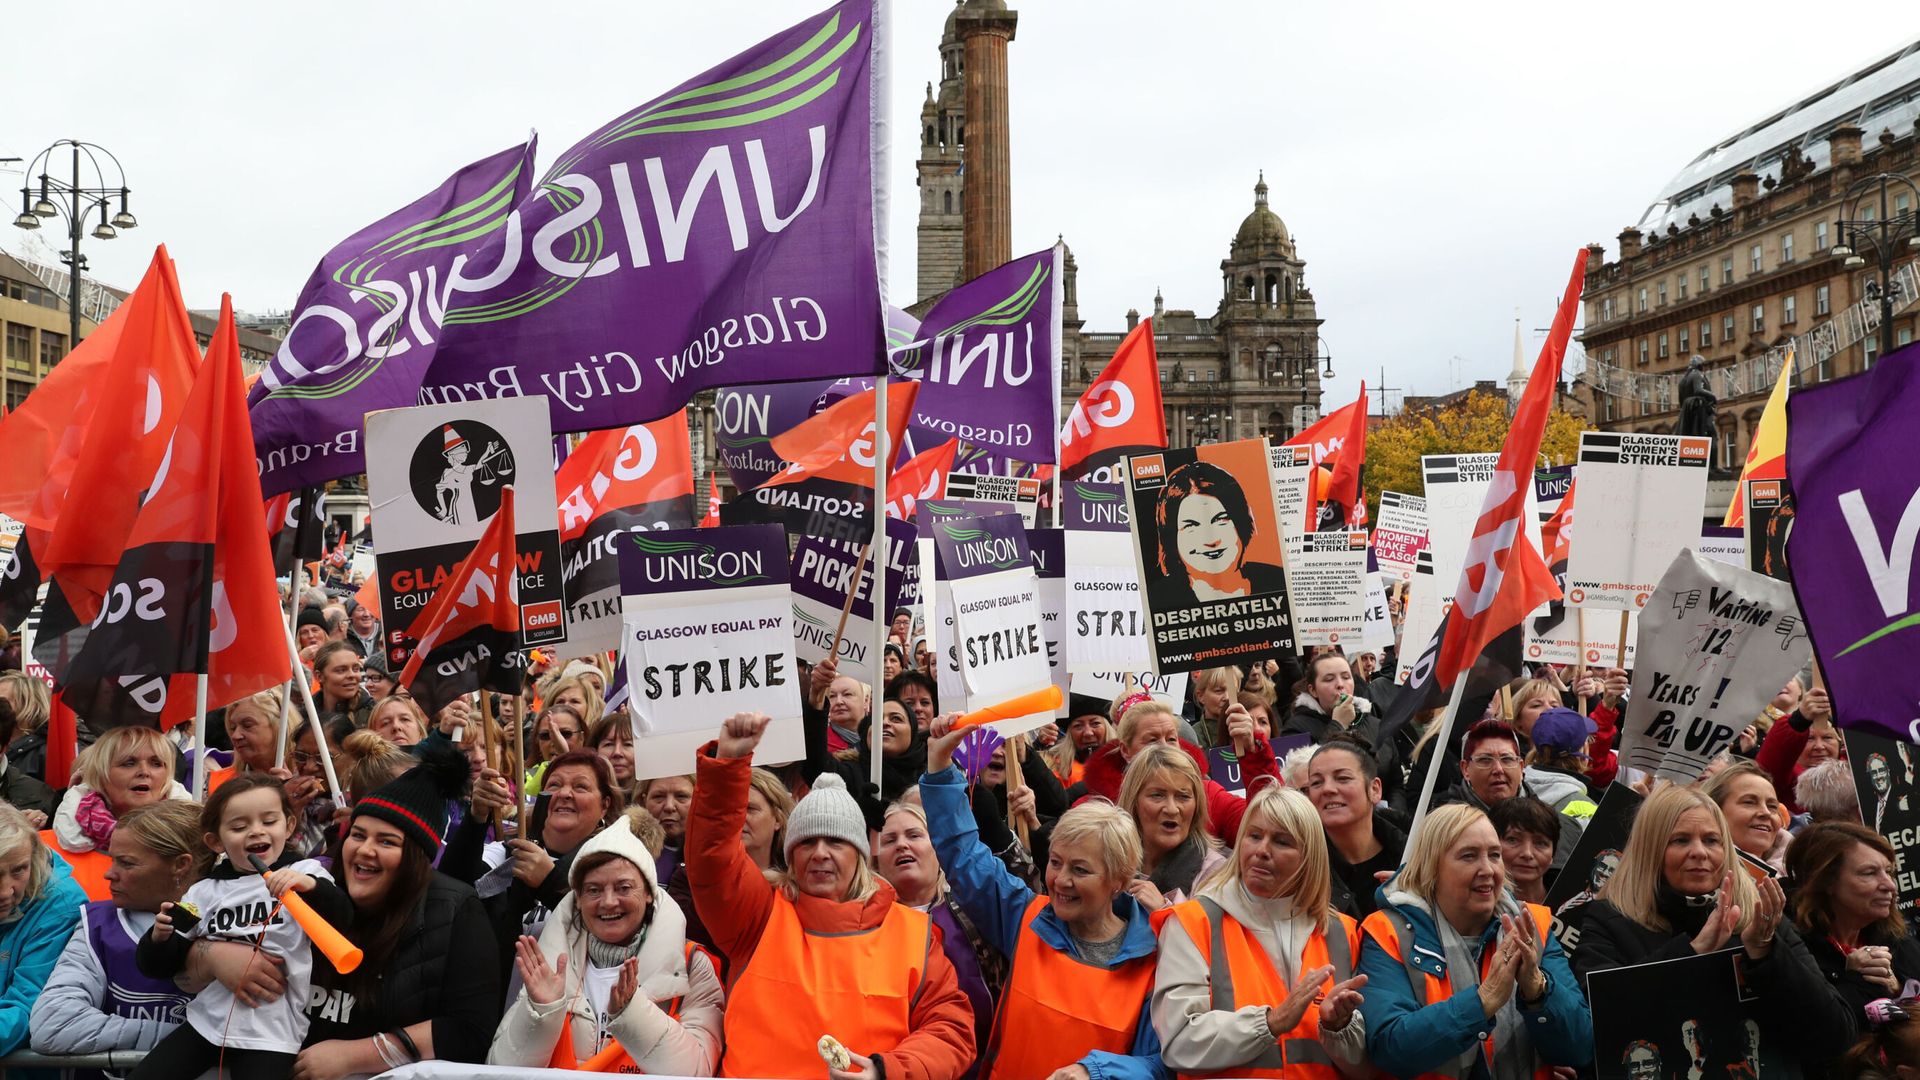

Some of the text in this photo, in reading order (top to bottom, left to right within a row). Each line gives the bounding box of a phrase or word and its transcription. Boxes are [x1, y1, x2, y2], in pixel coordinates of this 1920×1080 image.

[1621, 435, 1679, 446] GLASGOW
[1621, 444, 1678, 455] WOMEN'S
[1682, 446, 1705, 456] GMB
[1619, 453, 1677, 466] STRIKE
[1136, 464, 1161, 475] GMB
[976, 483, 1017, 493] WOMEN'S
[977, 476, 1018, 486] GLASGOW
[975, 490, 1017, 502] STRIKE
[1020, 486, 1036, 494] GMB
[1755, 488, 1777, 497] GMB
[1400, 503, 1427, 513] STRIKE
[1377, 529, 1418, 546] WOMEN
[955, 536, 1020, 569] UNISON
[1313, 545, 1349, 553] STRIKE
[1376, 539, 1407, 553] MAKE
[644, 550, 763, 583] UNISON
[1074, 581, 1124, 592] GLASGOW
[960, 591, 1034, 615] GLASGOW EQUAL PAY
[1153, 595, 1285, 628] DESPERATELY
[528, 612, 558, 627] GMB
[1076, 609, 1146, 638] STRI
[1321, 615, 1349, 623] WORTH
[635, 616, 783, 642] GLASGOW EQUAL PAY
[1157, 613, 1290, 645] SEEKING SUSAN
[965, 623, 1040, 669] STRIKE
[1700, 627, 1734, 656] 12
[1161, 637, 1293, 665] www.gmbscotland.org
[643, 651, 787, 701] STRIKE
[207, 899, 285, 935] EQUAL
[305, 983, 358, 1025] PAY
